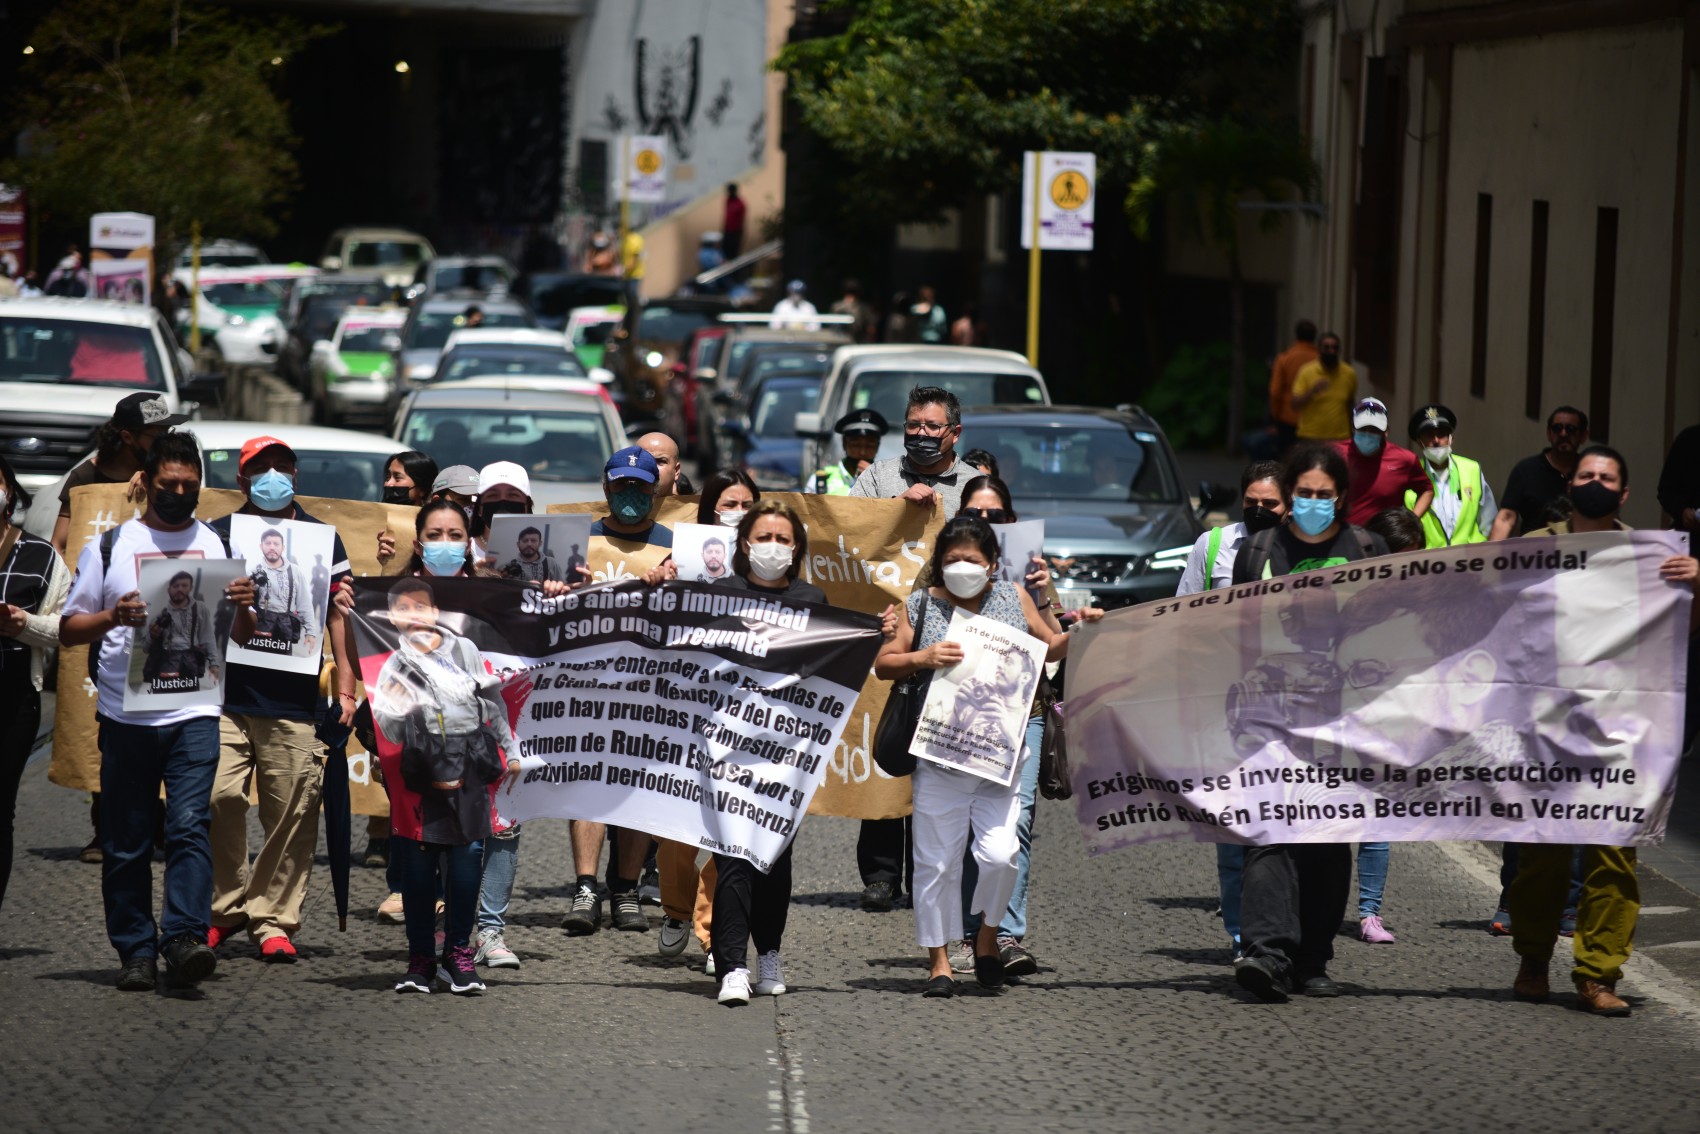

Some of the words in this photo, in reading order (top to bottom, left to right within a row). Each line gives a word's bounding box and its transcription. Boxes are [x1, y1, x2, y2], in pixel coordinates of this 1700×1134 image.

[1152, 602, 1180, 617] 31
[1189, 594, 1219, 608] de
[1224, 580, 1285, 605] julio
[1292, 573, 1324, 589] de
[1331, 562, 1393, 585] 2015
[1400, 558, 1447, 580] ¡No
[1454, 557, 1485, 573] se
[1493, 550, 1588, 570] olvida!
[521, 588, 579, 615] Siete
[584, 587, 643, 609] años
[648, 588, 677, 612] de
[681, 589, 811, 632] impunidad
[548, 626, 561, 646] y
[564, 614, 615, 640] solo
[620, 616, 662, 643] una
[666, 624, 770, 658] pregunta
[979, 630, 991, 639] de
[991, 633, 1011, 647] julio
[614, 656, 701, 681] entender
[699, 668, 711, 684] a
[818, 695, 845, 718] de
[531, 701, 565, 722] que
[569, 697, 605, 719] hay
[608, 701, 689, 730] pruebas
[534, 674, 552, 690] la
[626, 680, 651, 692] de
[655, 677, 718, 707] México
[742, 702, 772, 728] del
[773, 713, 832, 746] estado
[519, 735, 577, 758] crimen
[580, 732, 605, 752] de
[610, 730, 683, 765] Rubén
[754, 777, 791, 802] por
[524, 761, 603, 784] actividad
[1087, 772, 1195, 800] Exigimos
[1202, 775, 1232, 793] se
[1240, 763, 1375, 789] investigue
[1384, 764, 1407, 783] la
[1416, 761, 1582, 787] persecución
[1590, 766, 1636, 788] que
[1096, 803, 1172, 831] sufrió
[1177, 805, 1250, 827] Rubén
[1259, 799, 1365, 826] Espinosa
[1374, 796, 1482, 818] Becerril
[1490, 801, 1524, 818] en
[1531, 798, 1646, 823] Veracruz
[732, 844, 743, 855] 30
